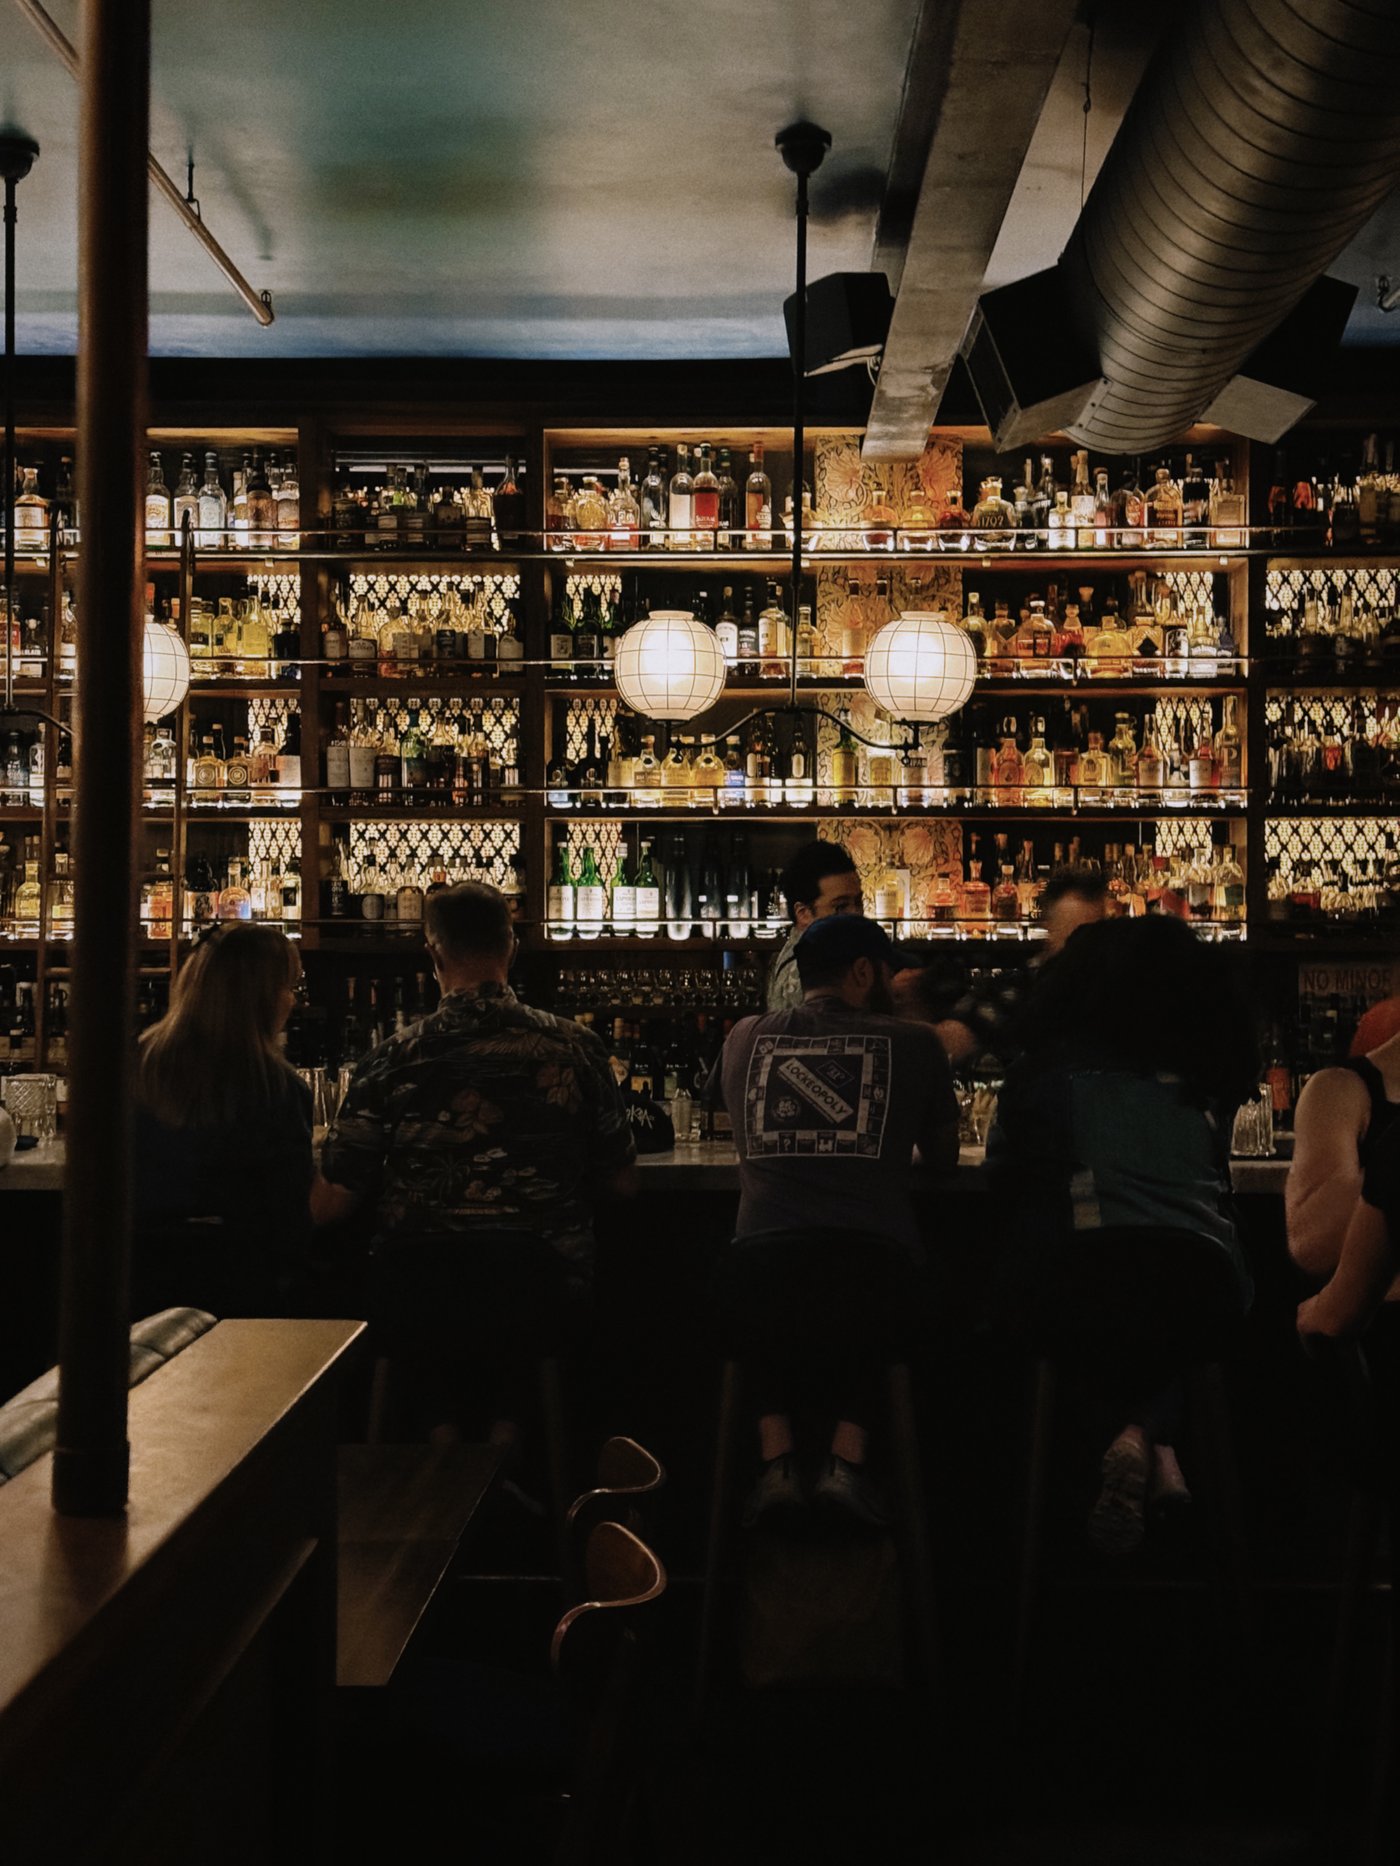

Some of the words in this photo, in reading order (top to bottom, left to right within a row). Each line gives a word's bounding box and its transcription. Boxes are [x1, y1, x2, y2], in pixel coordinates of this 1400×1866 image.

[1304, 969, 1329, 991] NO
[1335, 968, 1391, 991] MINOR
[785, 1063, 846, 1114] LOCKEOPOLY
